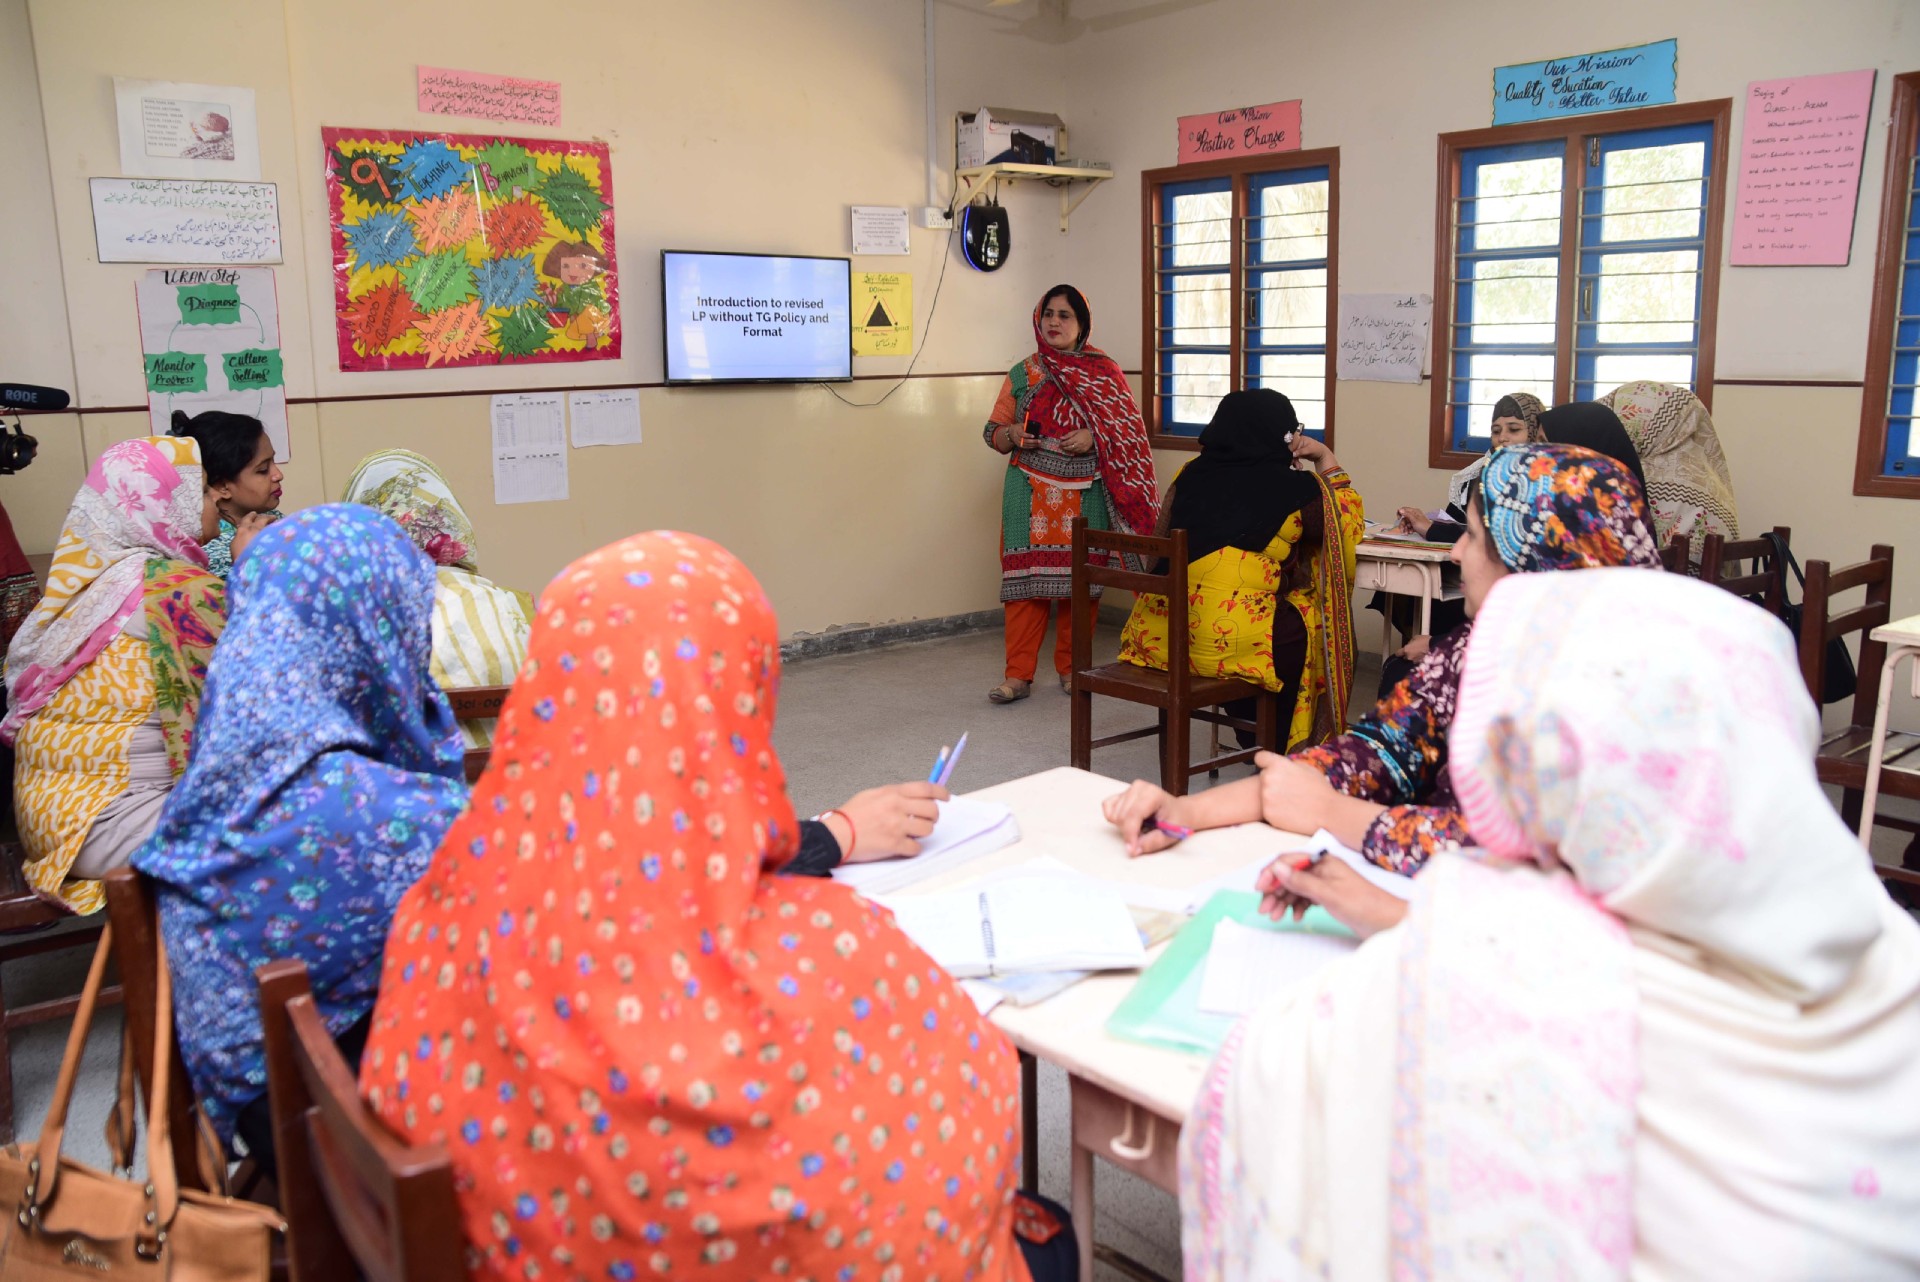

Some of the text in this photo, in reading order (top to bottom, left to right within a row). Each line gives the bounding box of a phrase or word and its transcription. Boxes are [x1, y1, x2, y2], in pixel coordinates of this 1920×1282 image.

[1544, 55, 1645, 76] Our Mission
[1505, 75, 1616, 106] Quality Education
[1558, 87, 1649, 109] Better Future
[1218, 111, 1237, 124] Our
[1194, 125, 1285, 153] Positive Change
[351, 157, 392, 199] 9
[164, 269, 240, 285] URAN Step
[184, 297, 237, 312] Diagnose
[697, 296, 824, 309] Introduction to revised
[692, 311, 829, 326] LP without TG Policy and
[743, 326, 783, 337] Format
[151, 358, 195, 373] Monitor
[229, 353, 268, 367] Culture
[155, 374, 194, 386] Progress
